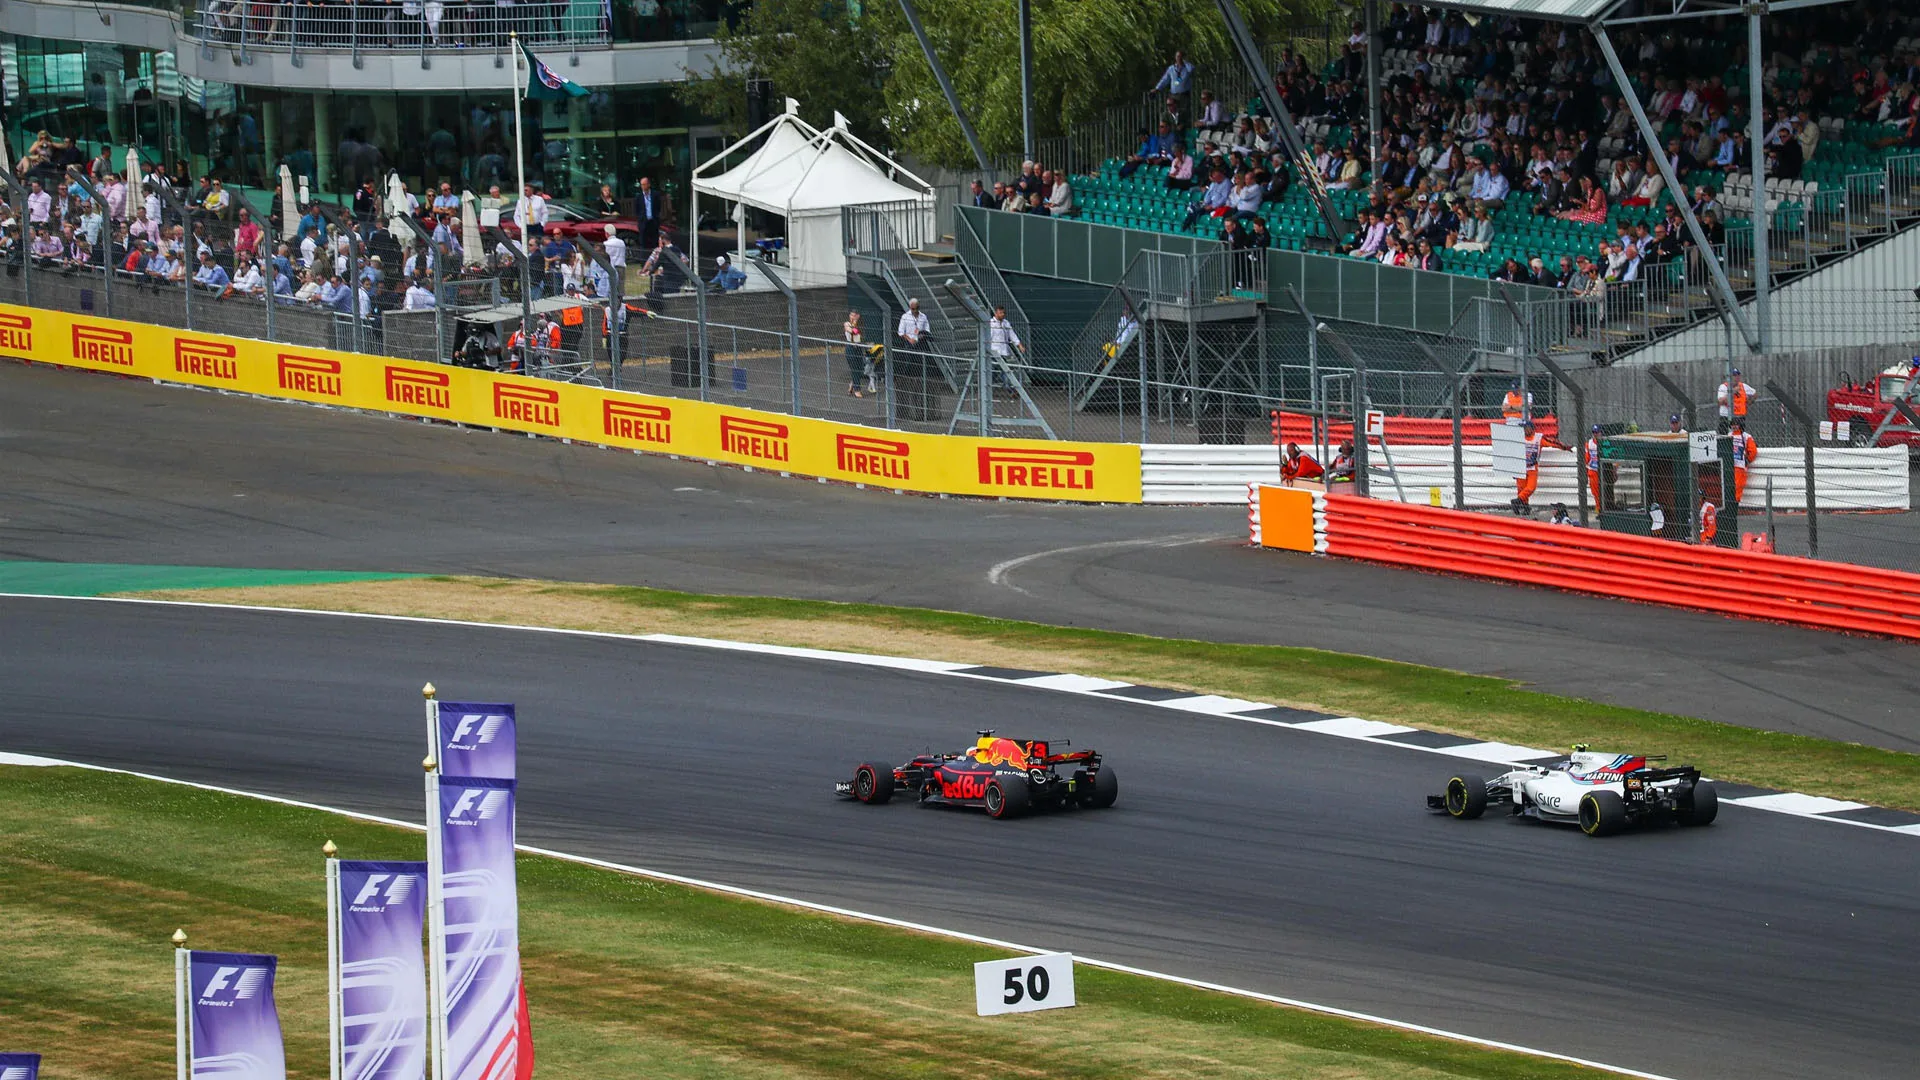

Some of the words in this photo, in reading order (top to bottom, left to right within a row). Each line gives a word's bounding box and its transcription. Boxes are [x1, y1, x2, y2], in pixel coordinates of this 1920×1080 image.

[72, 323, 134, 367] PIRELLI
[174, 336, 238, 380] PIRELLI
[277, 353, 342, 397] PIRELLI
[385, 365, 450, 410] PIRELLI
[493, 381, 560, 427] PIRELLI
[602, 398, 671, 444] PIRELLI
[1367, 412, 1381, 433] F
[720, 414, 789, 462] PIRELLI
[1697, 434, 1715, 443] ROW
[1704, 445, 1709, 457] 1
[836, 432, 910, 480] PIRELLI
[977, 446, 1095, 490] PIRELLI
[451, 714, 507, 744] F1
[447, 742, 470, 751] Formula
[1033, 742, 1047, 758] 3
[1583, 772, 1625, 782] MARTINI
[449, 789, 509, 819] F1
[446, 818, 470, 826] Formula
[352, 874, 417, 905] F1
[202, 966, 268, 999] F1
[1003, 965, 1050, 1005] 50
[198, 998, 228, 1006] Formula
